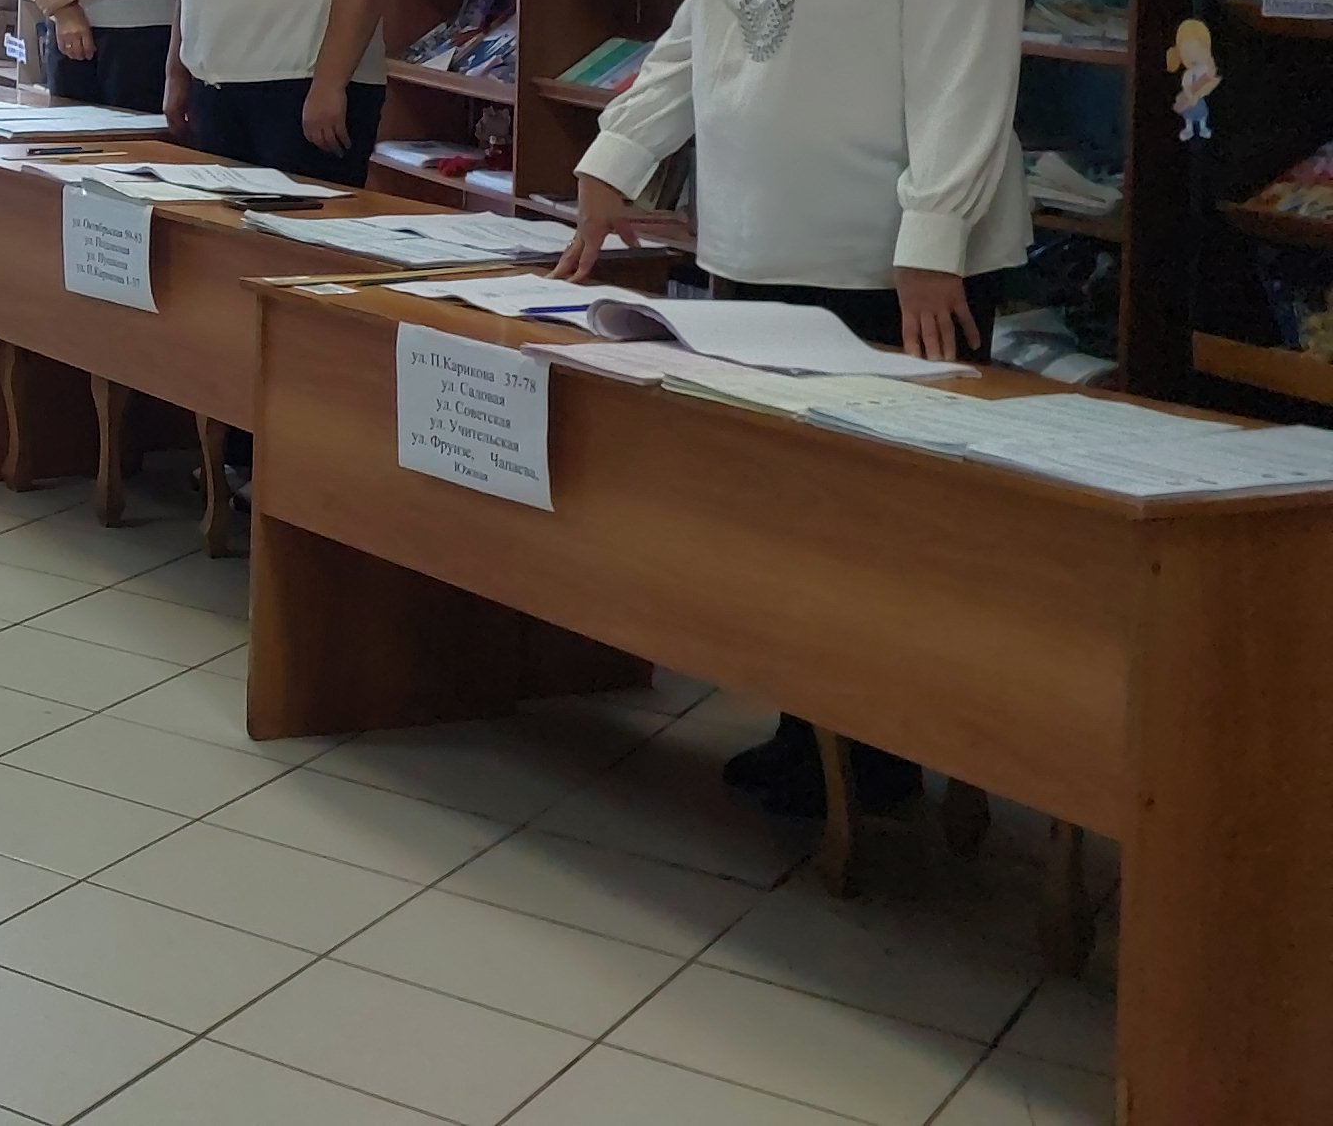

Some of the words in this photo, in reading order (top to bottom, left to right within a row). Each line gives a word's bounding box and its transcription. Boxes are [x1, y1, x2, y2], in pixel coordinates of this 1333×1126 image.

[411, 351, 427, 365] ул.
[504, 372, 537, 394] 37-78
[459, 382, 506, 407] Садовая
[436, 398, 452, 412] ул.
[455, 400, 512, 429] Советская
[411, 431, 427, 445] ул.
[430, 435, 475, 460] Фрунзе,
[429, 417, 446, 430] ул.
[449, 418, 520, 452] Учительская
[454, 461, 489, 482] Южная
